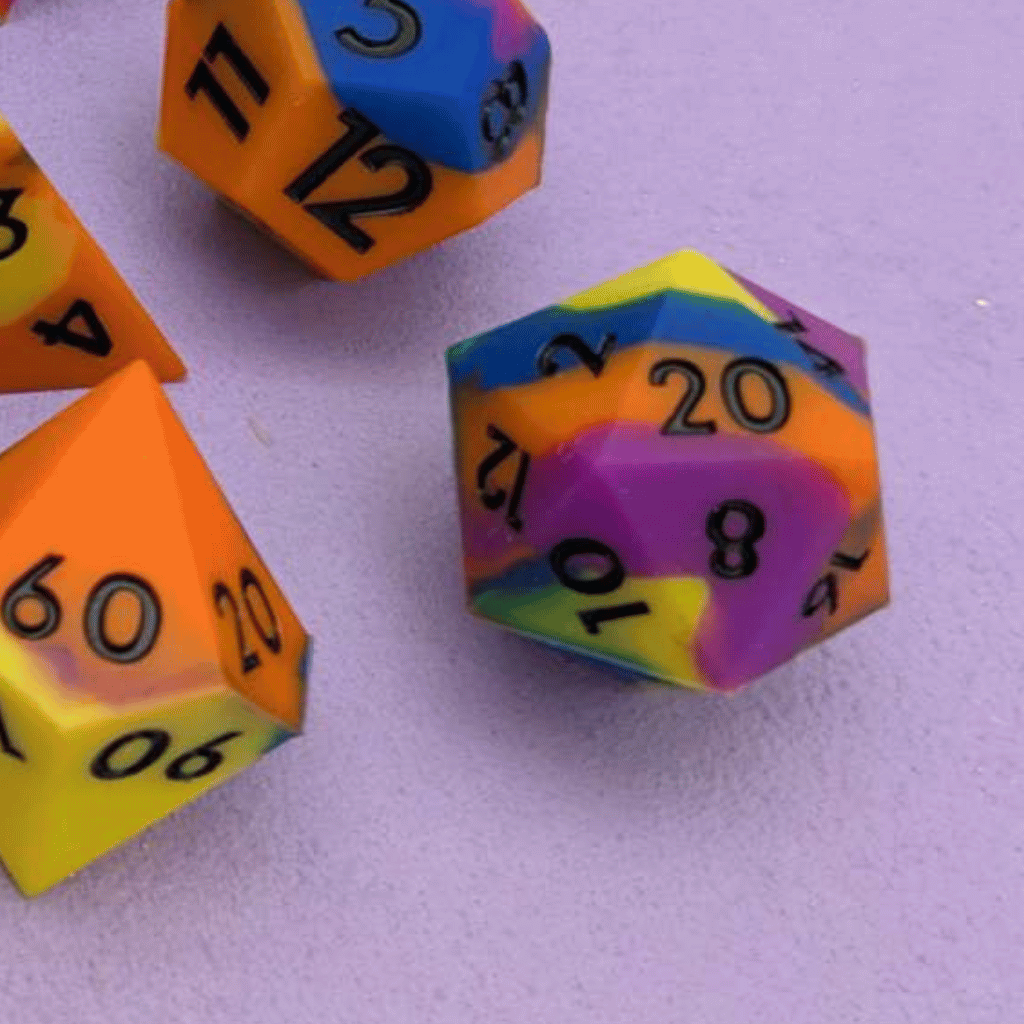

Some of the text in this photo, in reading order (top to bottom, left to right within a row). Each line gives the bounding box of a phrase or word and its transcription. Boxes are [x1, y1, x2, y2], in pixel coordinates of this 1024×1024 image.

[184, 21, 271, 144] 11
[282, 107, 433, 255] 12
[30, 298, 113, 357] 4
[647, 357, 792, 436] 20
[477, 424, 531, 532] 12
[548, 536, 652, 636] 10
[705, 499, 767, 580] 8
[0, 552, 164, 665] 60
[212, 567, 282, 674] 20
